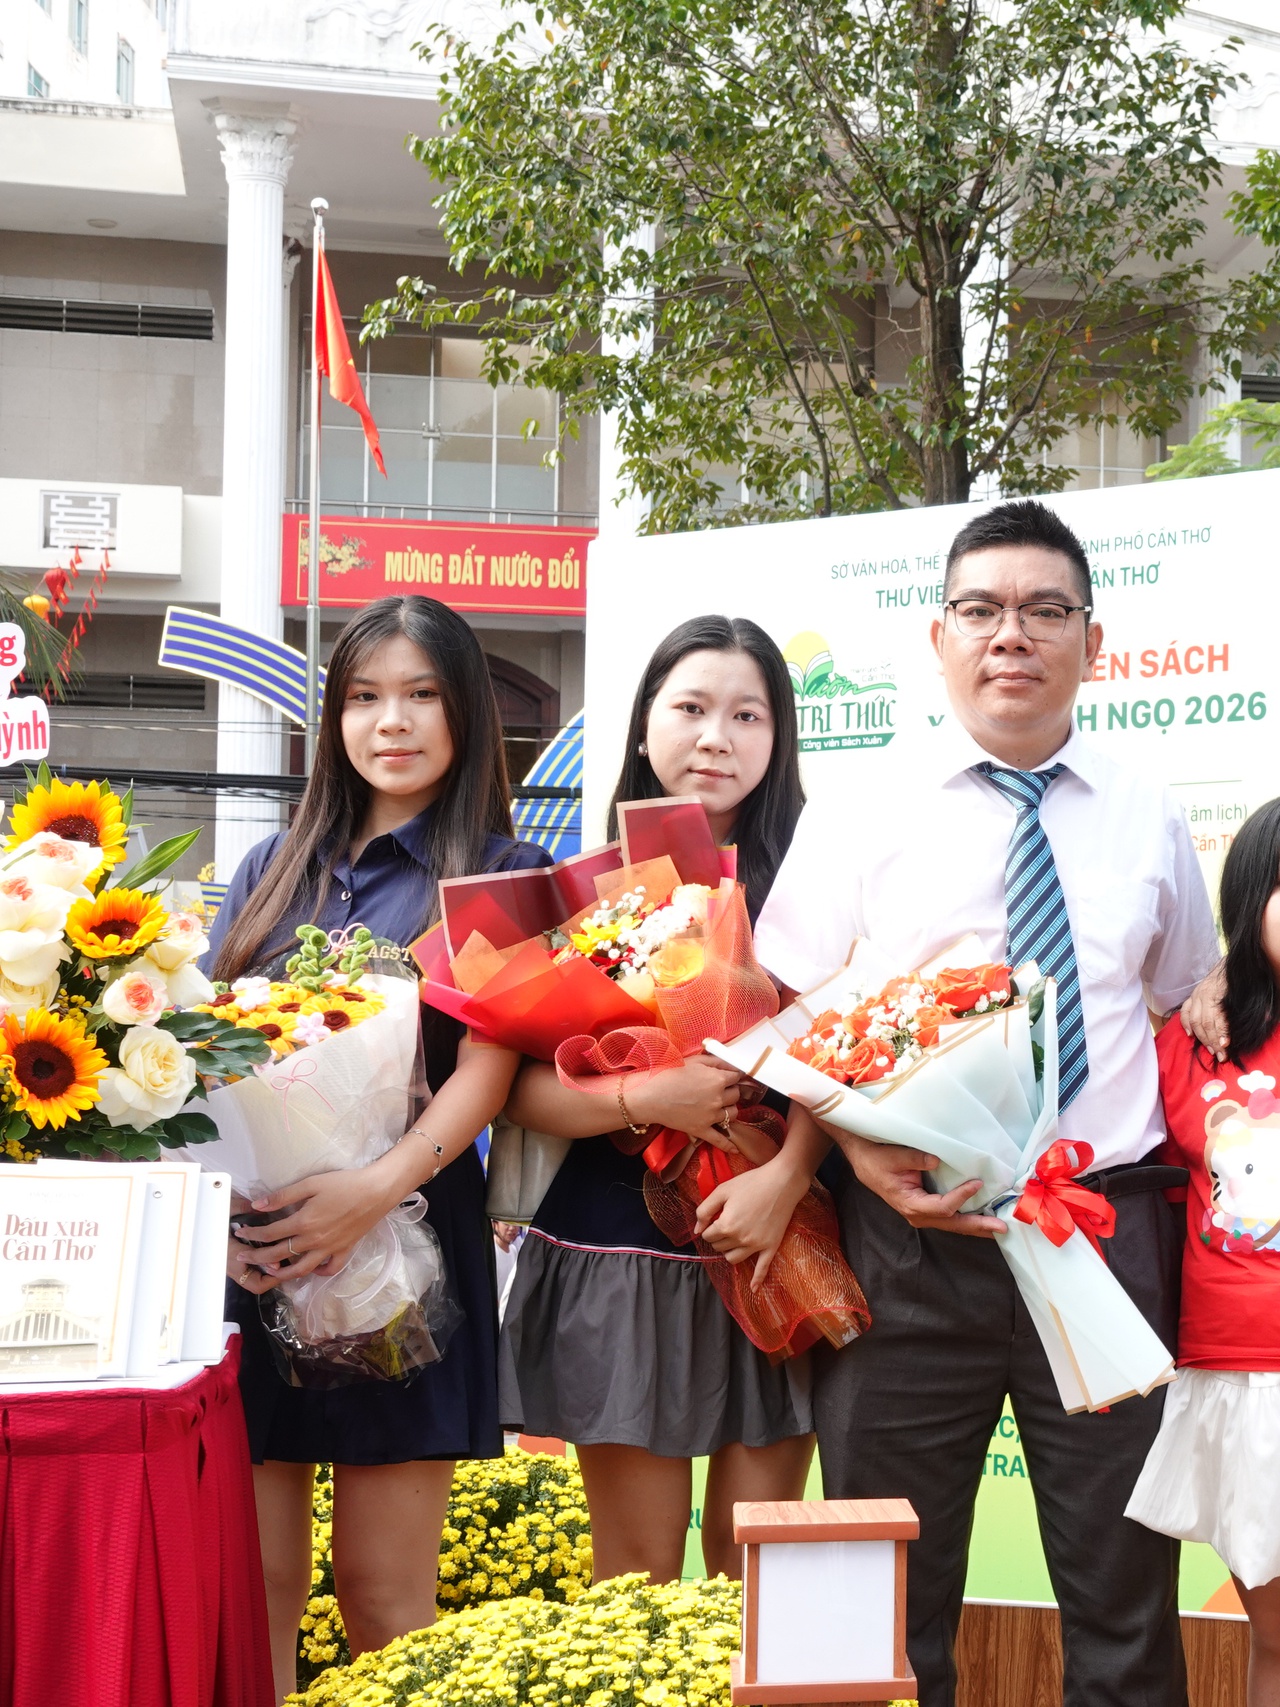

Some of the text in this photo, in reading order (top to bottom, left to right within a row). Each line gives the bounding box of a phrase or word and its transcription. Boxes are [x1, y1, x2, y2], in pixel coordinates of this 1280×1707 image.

[385, 544, 579, 589] MỪNG ĐẤT NƯỚC ĐỔI
[831, 560, 850, 579] SỞ
[852, 558, 877, 577] VĂN
[1081, 537, 1110, 554] ÀNH
[1114, 529, 1143, 551] PHỐ
[1181, 526, 1211, 545] THƠ
[876, 561, 1161, 608] THƯ VIỆ ẦN THƠ
[1139, 640, 1229, 678] SÁCH
[840, 694, 896, 731] THỨC
[1107, 698, 1175, 735] NGỌ
[1185, 691, 1267, 724] 2026
[802, 735, 882, 750] Công viên Sách Xuân
[1190, 804, 1212, 822] âm
[4, 1213, 99, 1237] Dấu xưa
[2, 1238, 96, 1261] Cần Thơ
